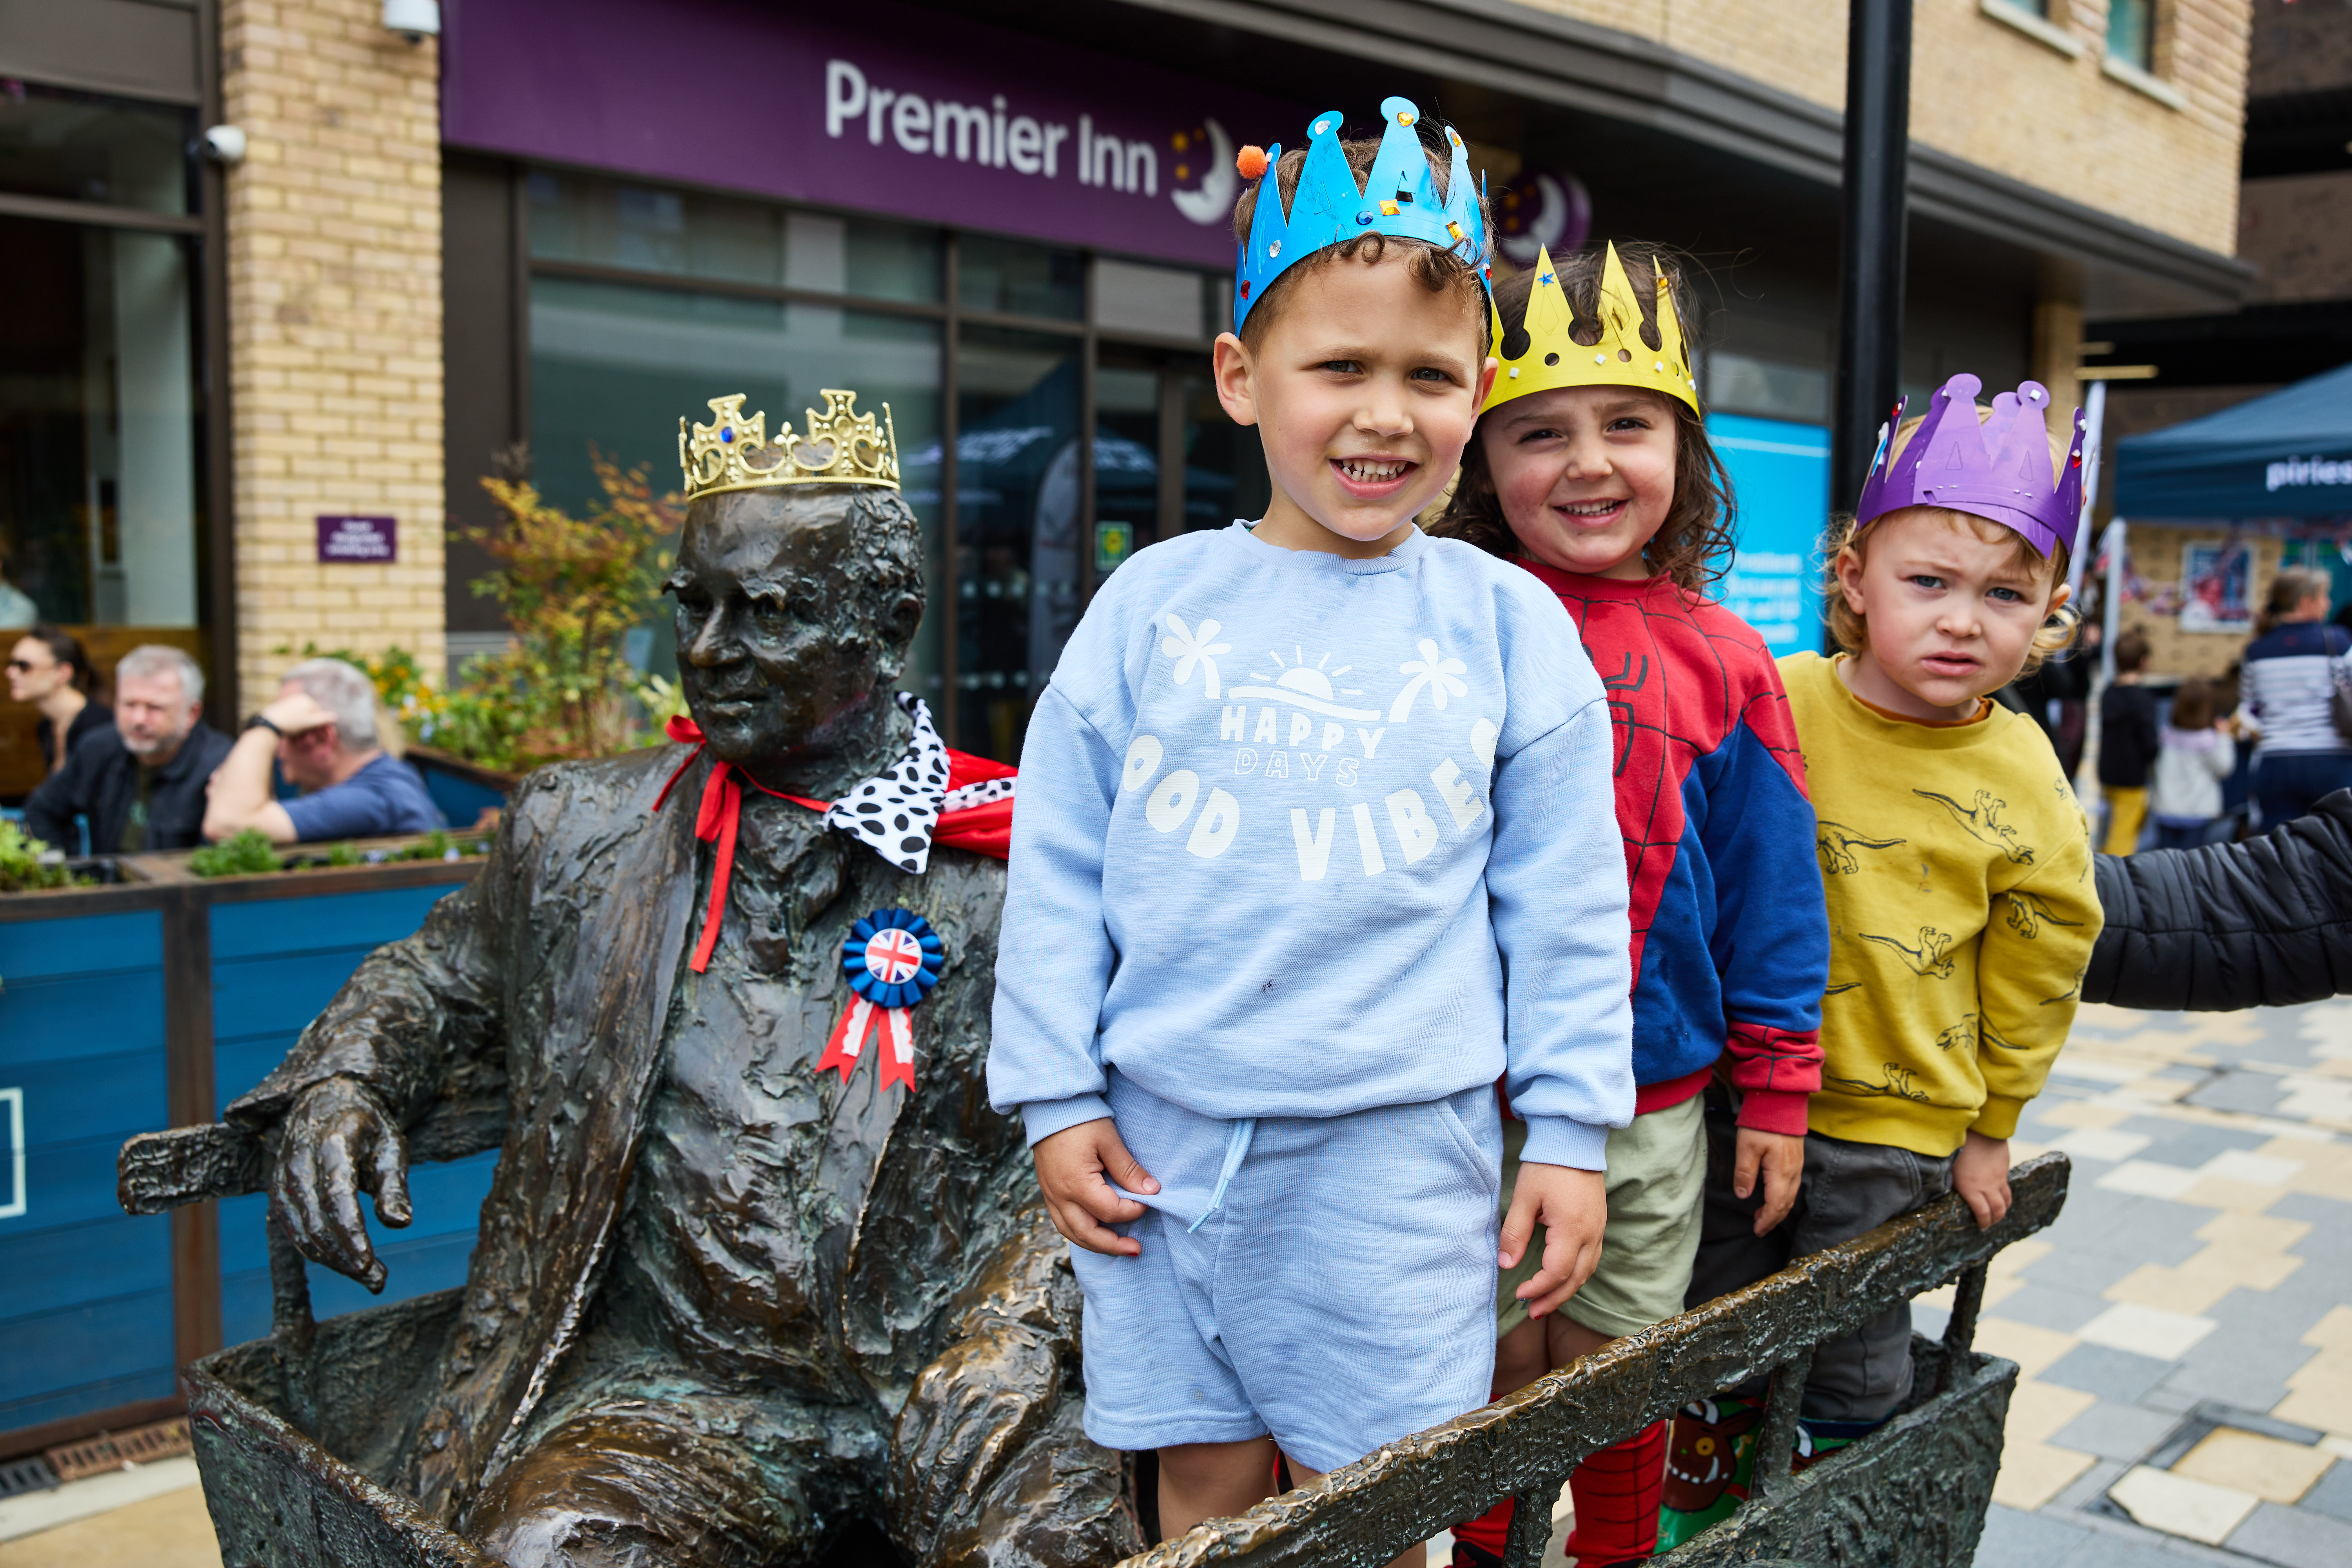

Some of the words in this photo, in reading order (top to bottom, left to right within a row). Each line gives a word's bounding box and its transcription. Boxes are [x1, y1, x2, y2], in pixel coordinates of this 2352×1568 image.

[826, 59, 1068, 178] Premier
[1078, 114, 1158, 197] Inn
[1220, 705, 1386, 759] HAPPY
[1235, 748, 1360, 787] DAYS
[1123, 735, 1240, 858] OOD
